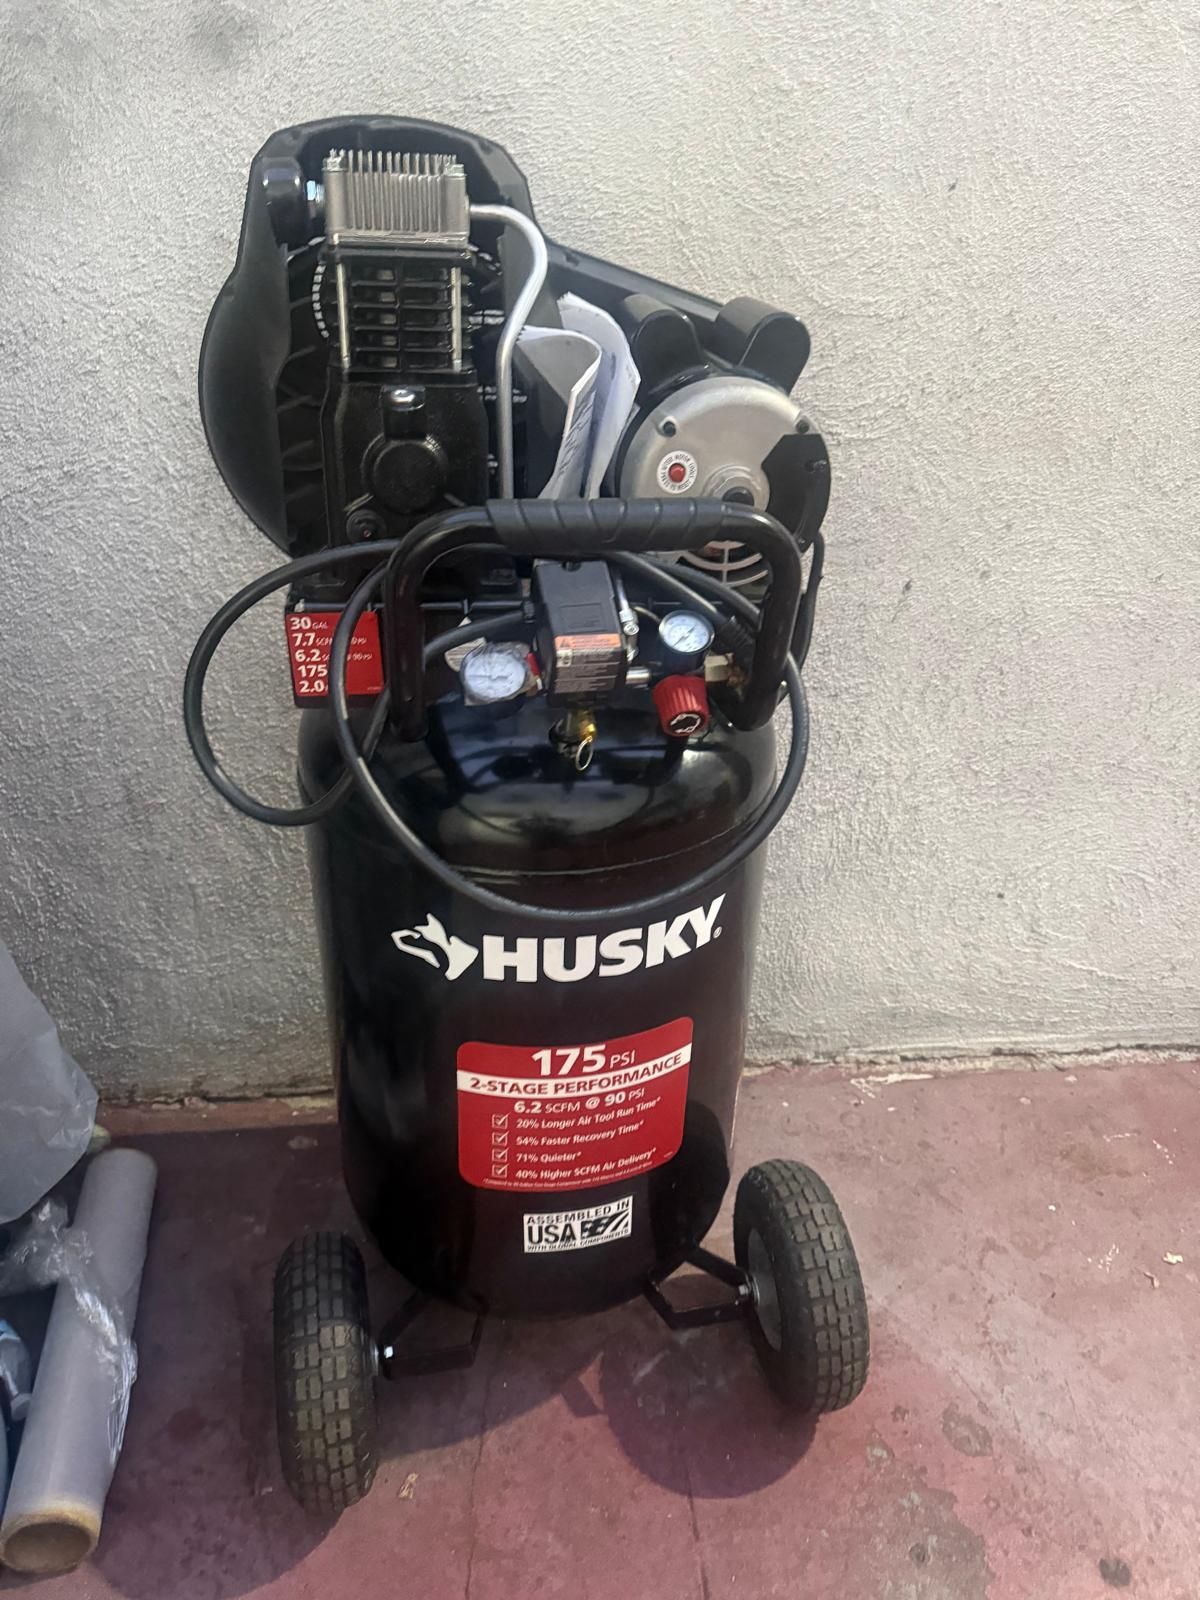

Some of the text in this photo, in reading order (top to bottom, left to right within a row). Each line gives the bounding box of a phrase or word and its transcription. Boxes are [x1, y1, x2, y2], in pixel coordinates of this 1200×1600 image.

[290, 617, 311, 630] 30
[292, 632, 315, 647] 7.7
[295, 649, 321, 662] 6.2
[298, 664, 328, 678] 175
[299, 680, 325, 693] 2.0
[482, 892, 726, 983] HUSKY
[531, 1044, 636, 1076] 175 PSI
[470, 1052, 682, 1096] 2-STAGE PERFORMANCE
[514, 1088, 645, 1114] 6.2 SCFM @ 90 PSI
[516, 1119, 540, 1129] 20%
[541, 1119, 576, 1130] Longer
[577, 1116, 592, 1127] Air
[595, 1111, 615, 1123] Tool
[616, 1107, 635, 1119] Run
[516, 1137, 539, 1146] 54%
[541, 1136, 571, 1147] Faster
[573, 1129, 616, 1144] Recovery
[516, 1152, 539, 1163] 71%
[515, 1169, 538, 1179] 40%
[540, 1168, 572, 1181] Higher
[574, 1164, 601, 1177] SCFM
[602, 1161, 616, 1172] Air
[527, 1198, 630, 1225] ASSEMBLED IN
[527, 1223, 577, 1245] USA
